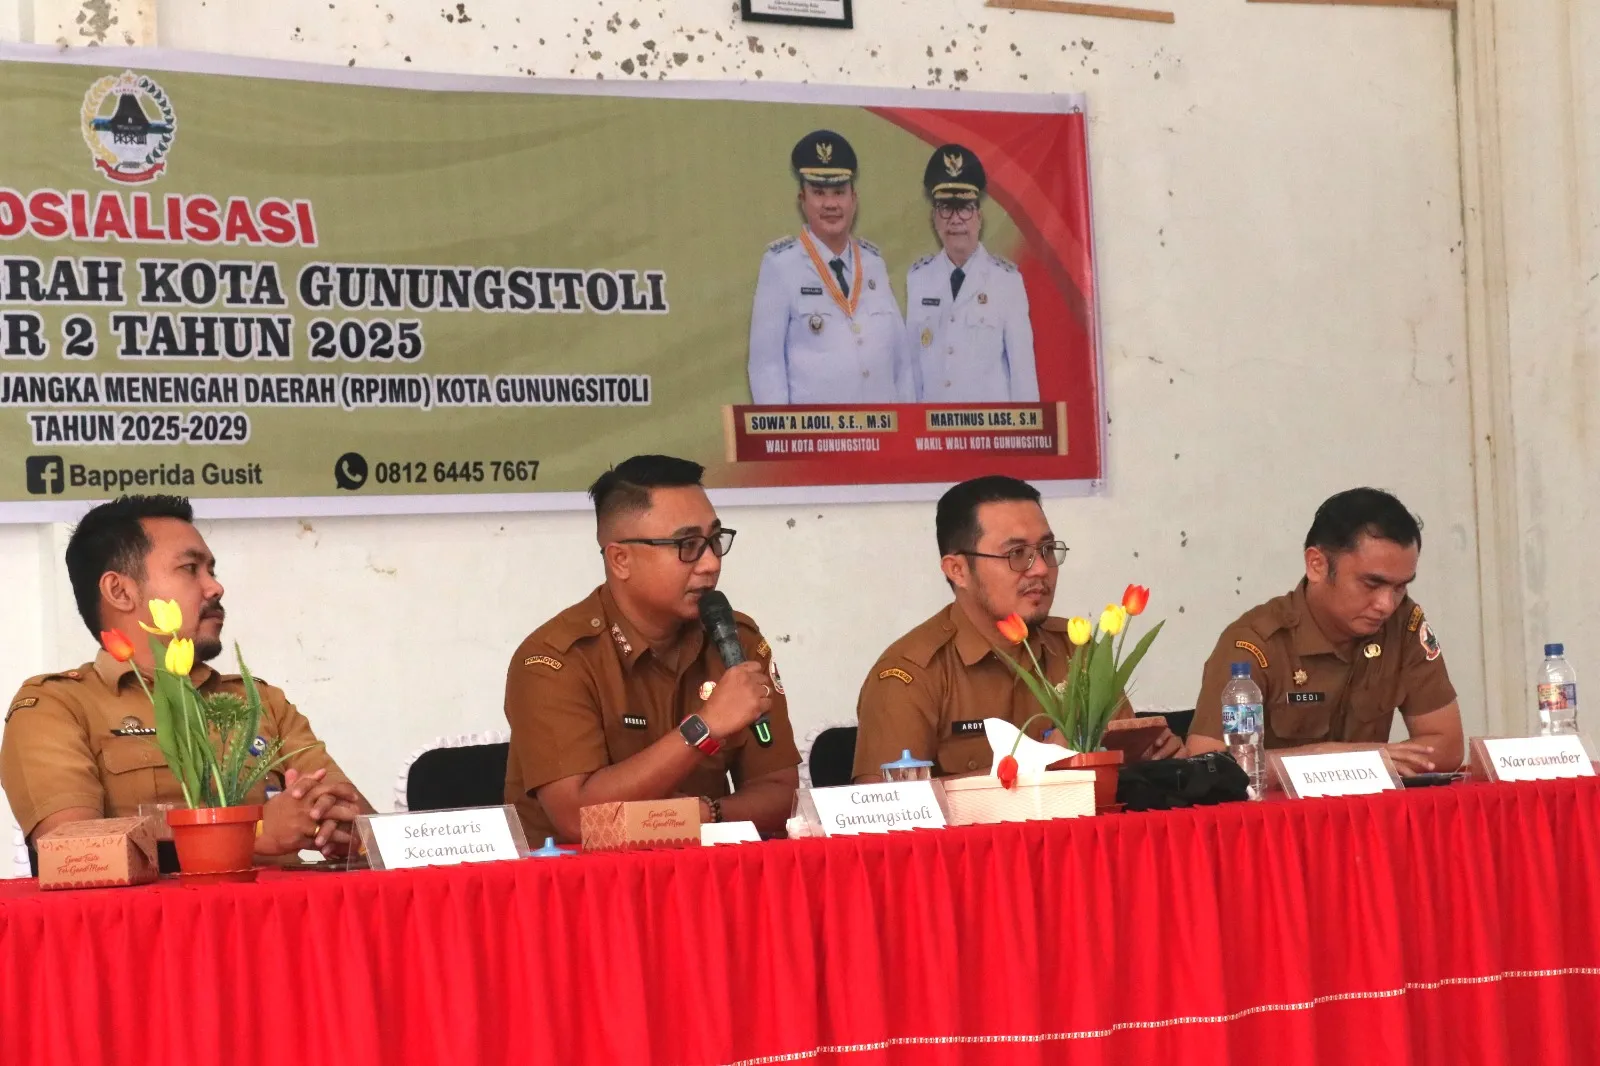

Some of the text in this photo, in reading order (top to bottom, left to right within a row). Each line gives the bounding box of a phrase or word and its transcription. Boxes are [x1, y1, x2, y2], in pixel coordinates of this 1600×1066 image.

[0, 192, 315, 244] OSIALISASI
[0, 259, 666, 311] RAH KOTA GUNUNGSITOLI
[65, 317, 94, 357] 2
[113, 315, 292, 358] TAHUN
[310, 321, 422, 359] 2025
[1, 376, 650, 407] JANGKA MENENGAH DAERAH (RPJMD) KOTA GUNUNGSITOLI
[31, 415, 248, 442] TAHUN 2025-2029
[750, 413, 892, 432] SOWA'A LAOLI, S.E., M.Si
[930, 411, 1038, 427] MARTINUS LASE, S.H
[765, 438, 880, 453] WALI KOTA GUNUNGSITOLI
[915, 435, 1053, 451] WAKIL WALI KOTA GUNUNGSITOLI
[69, 462, 263, 491] Bapperida Gusit
[375, 460, 540, 484] 0812 6445 7667
[1296, 694, 1319, 702] DEDI
[962, 722, 983, 731] ARDY
[1500, 751, 1581, 769] Narasumber
[1302, 767, 1379, 785] BAPPERIDA
[850, 788, 901, 806] Camat
[835, 806, 932, 830] Gunungsitoli
[404, 821, 482, 839] Sekretaris
[405, 841, 496, 861] Kecamatan
